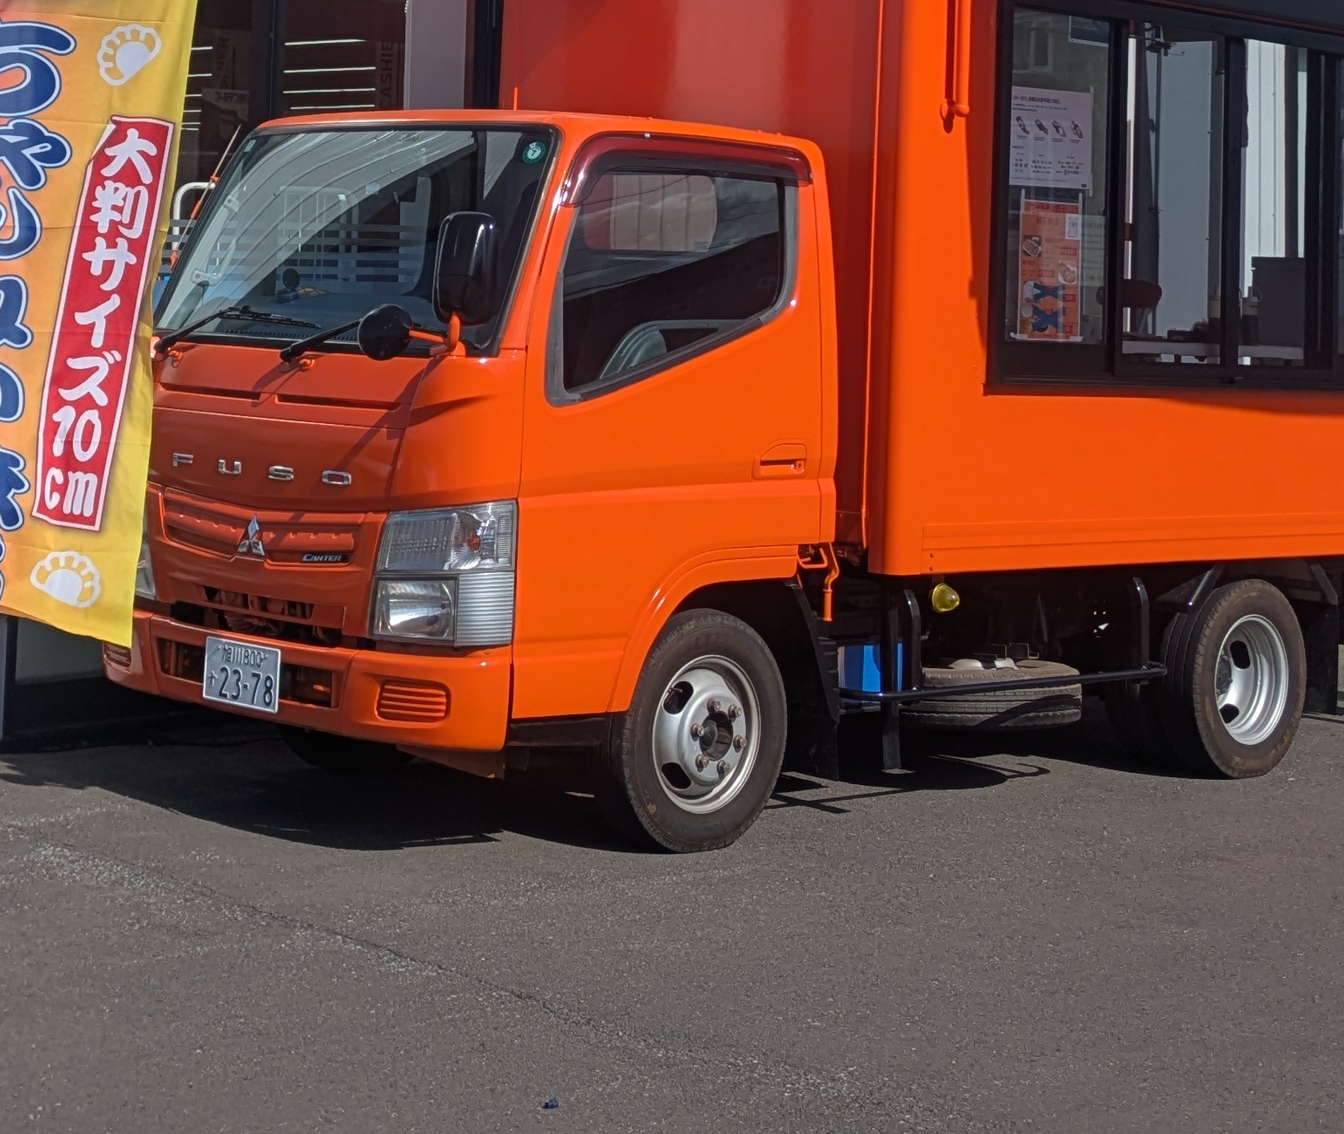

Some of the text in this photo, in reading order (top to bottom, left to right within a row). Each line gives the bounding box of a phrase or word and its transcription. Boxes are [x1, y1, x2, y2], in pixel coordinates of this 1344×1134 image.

[43, 127, 158, 518] 大判サイズ10cm
[172, 451, 353, 486] FUSO
[218, 665, 275, 707] 23-78
